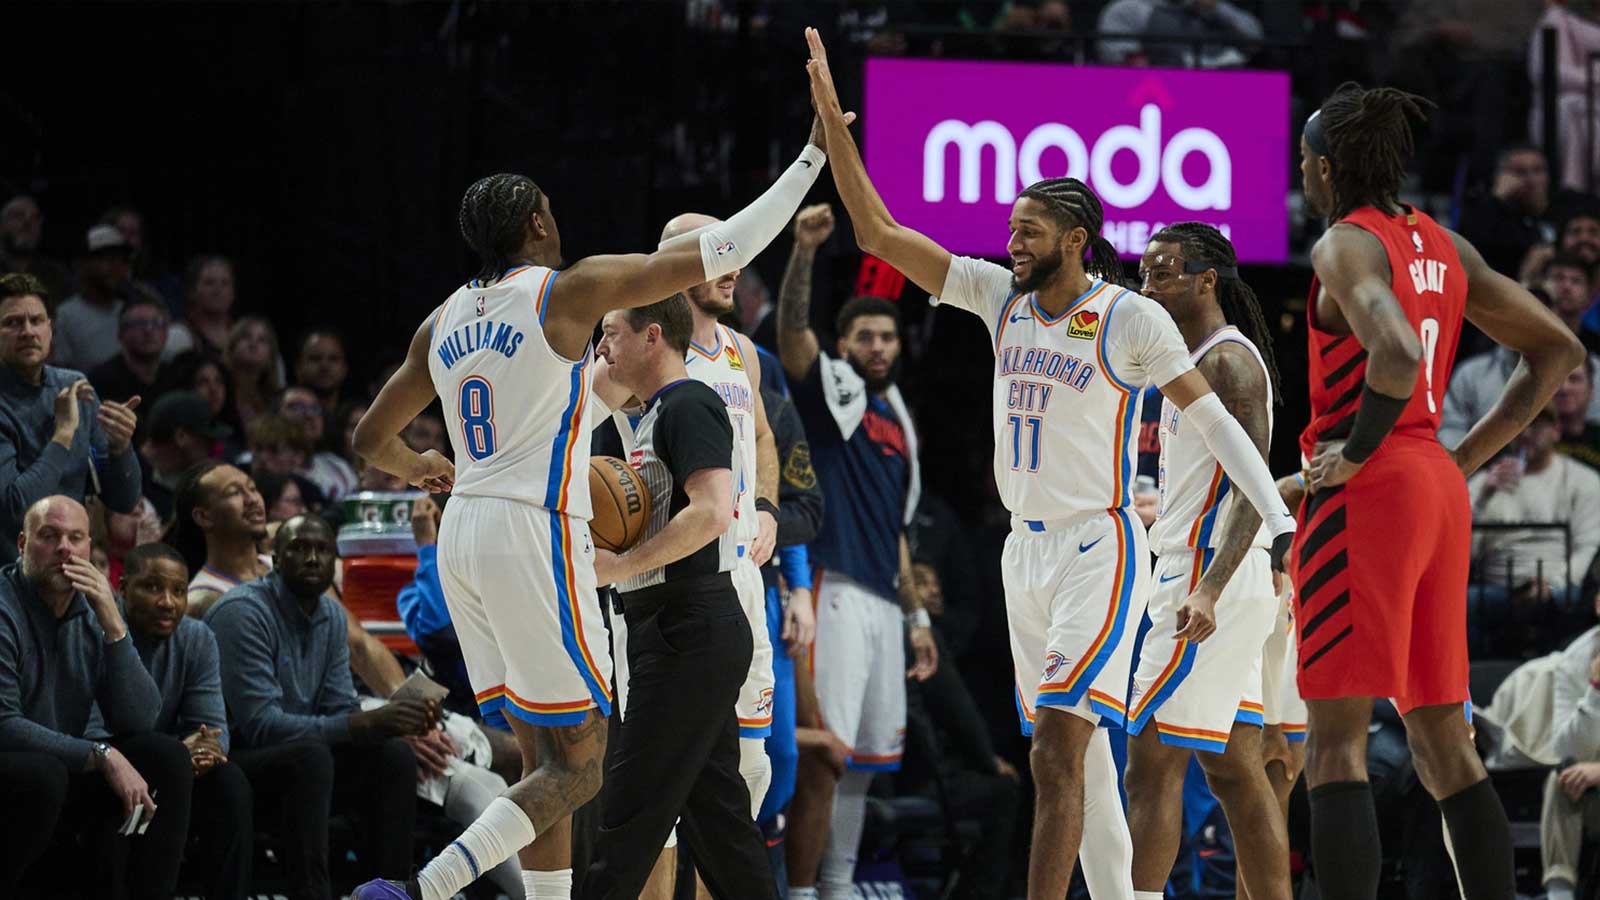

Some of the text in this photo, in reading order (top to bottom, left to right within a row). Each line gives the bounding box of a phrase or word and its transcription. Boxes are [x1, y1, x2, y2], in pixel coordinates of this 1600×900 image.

[923, 103, 1232, 211] moda
[437, 321, 524, 369] WILLIAMS
[998, 346, 1096, 393] KLAHOMA
[458, 375, 498, 462] 8
[1007, 380, 1053, 412] CITY
[1007, 413, 1043, 473] 11
[605, 458, 641, 516] Wilson
